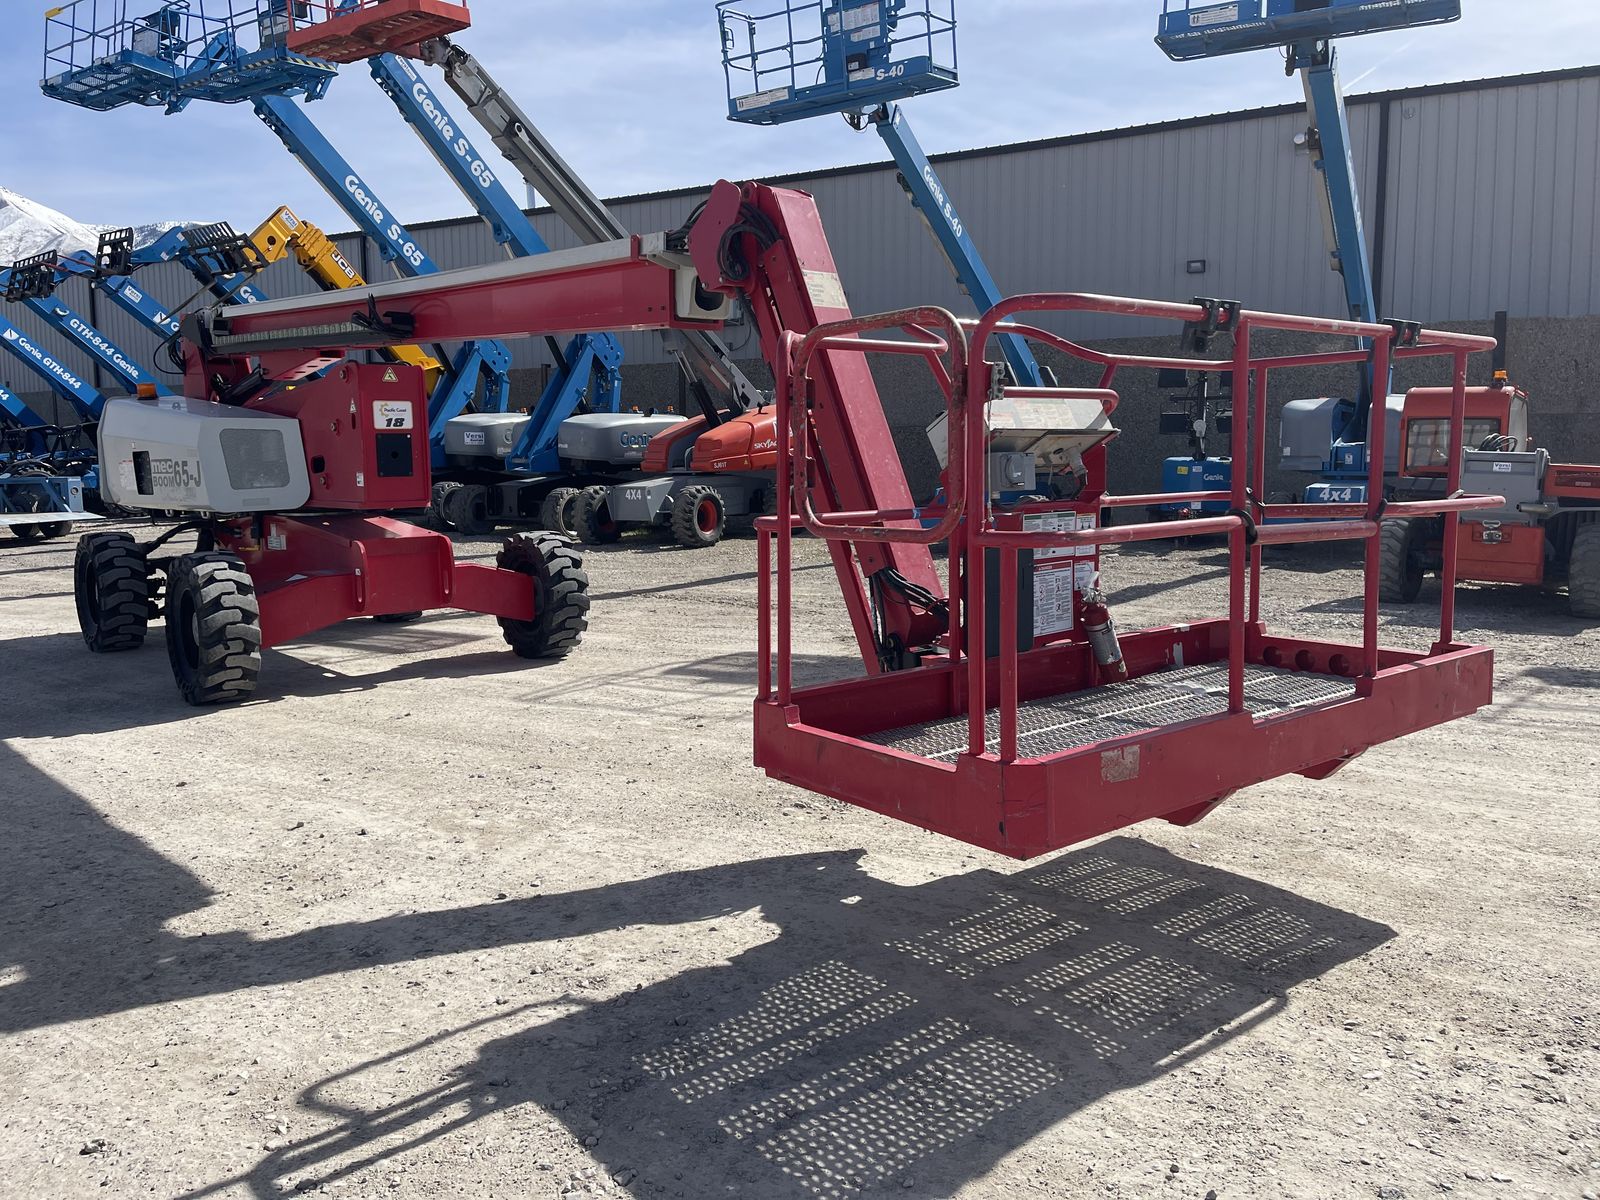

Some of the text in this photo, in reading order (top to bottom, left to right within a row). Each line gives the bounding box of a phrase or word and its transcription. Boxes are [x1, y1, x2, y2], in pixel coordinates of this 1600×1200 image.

[876, 65, 904, 81] S-40
[413, 83, 494, 188] Genie S-65
[924, 165, 962, 237] Genie S-40
[345, 175, 425, 266] Genie S-65
[331, 249, 355, 279] JCB
[69, 318, 139, 379] GTH-844 Genie
[18, 337, 81, 389] Genie GTH-844
[385, 417, 405, 428] 18
[153, 475, 174, 488] BOOM
[173, 460, 201, 487] 65-J
[1203, 473, 1224, 481] Genie
[625, 488, 642, 500] 4X4
[1319, 487, 1352, 501] 4x4
